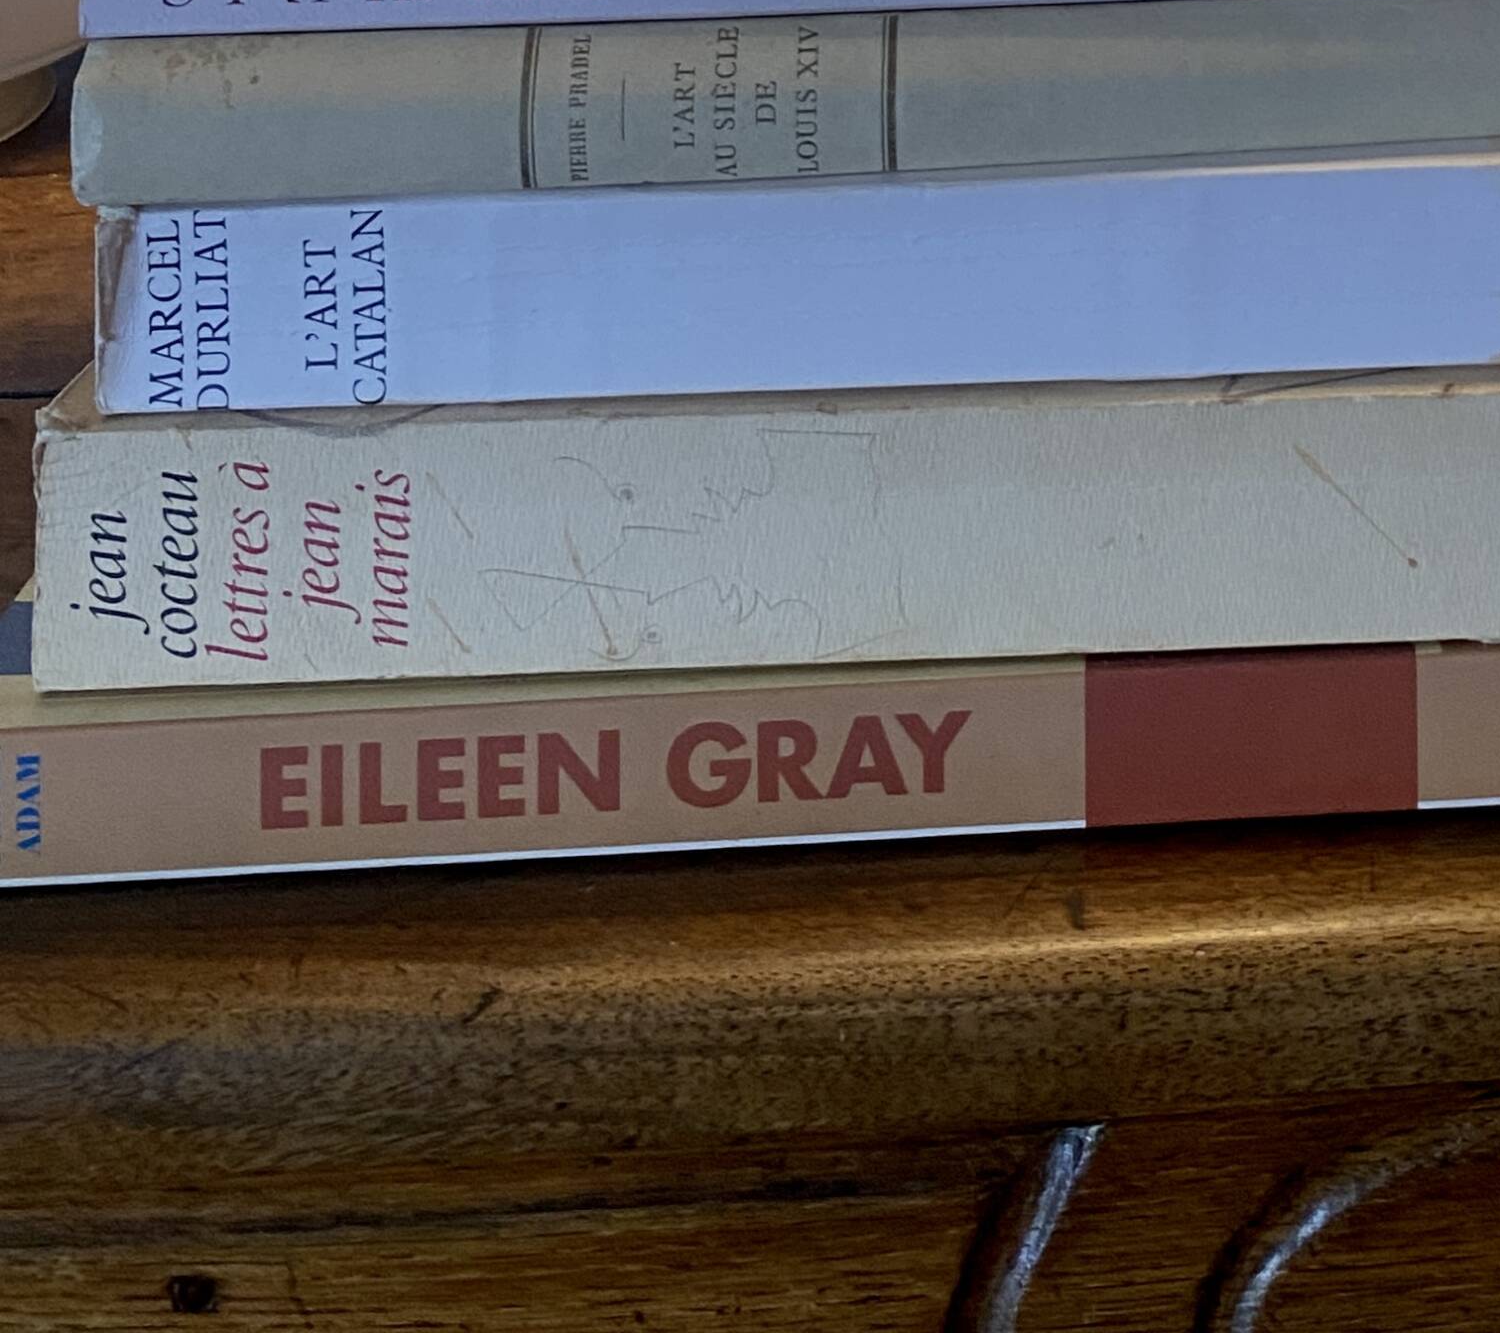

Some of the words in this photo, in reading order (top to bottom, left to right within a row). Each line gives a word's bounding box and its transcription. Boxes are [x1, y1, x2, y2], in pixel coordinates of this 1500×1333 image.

[567, 33, 592, 109] PRADEL
[672, 62, 697, 150] L'ART
[711, 26, 740, 131] SIÈCLE
[755, 79, 777, 126] DE
[797, 25, 820, 77] XIV
[567, 117, 589, 183] PIERRE
[714, 143, 739, 178] AU
[795, 88, 820, 174] LOUIS
[146, 218, 185, 408] MARCEL
[193, 209, 231, 410] DURLIAT
[302, 239, 338, 371] L'ART
[350, 209, 388, 405] CATALAN
[217, 461, 270, 491] à
[69, 510, 150, 636] jean
[152, 470, 199, 659] cocteau
[204, 507, 271, 661] lettres
[282, 500, 362, 625] jean
[355, 468, 411, 647] marais
[16, 753, 41, 856] ADAM
[258, 727, 622, 831] EILEEN
[665, 709, 974, 809] GRAY
